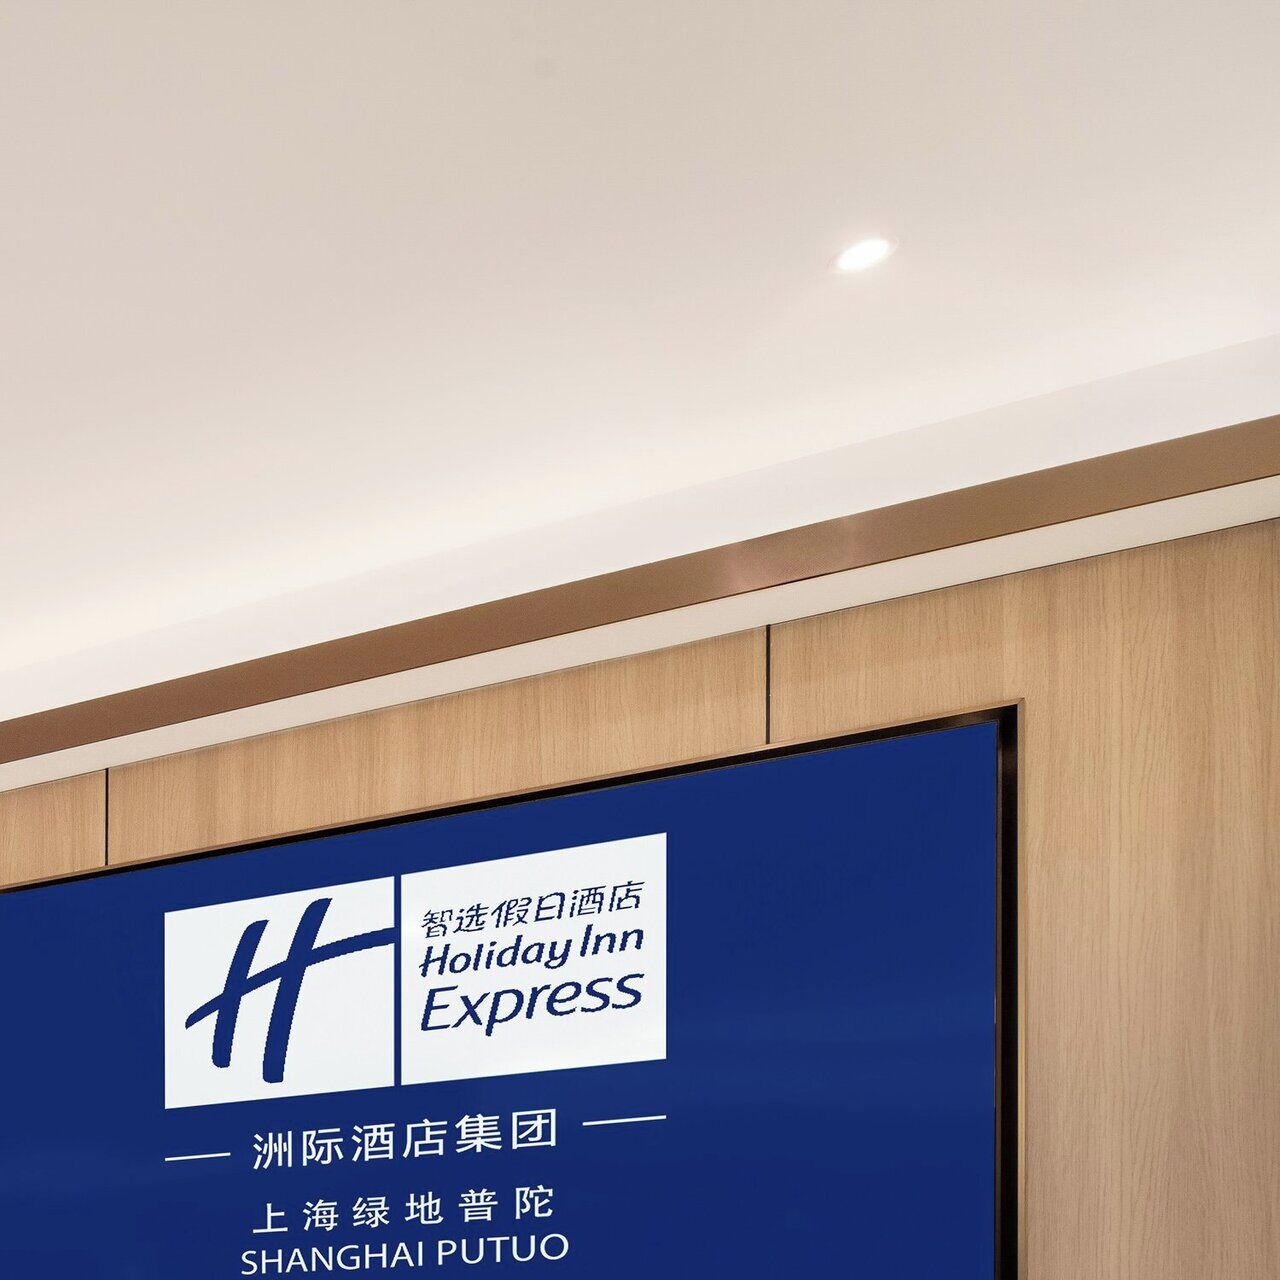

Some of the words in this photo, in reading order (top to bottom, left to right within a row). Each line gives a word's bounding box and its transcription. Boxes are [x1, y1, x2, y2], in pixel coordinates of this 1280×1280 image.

[421, 881, 645, 938] 智选假日酒店
[419, 934, 573, 977] Holiday
[580, 924, 644, 957] Inn
[421, 973, 645, 1036] Express
[253, 1109, 557, 1170] 洲际酒店集团
[253, 1185, 554, 1233] 上海绿地普陀
[241, 1241, 423, 1276] SHANGHAI
[437, 1233, 569, 1266] PUTUO
